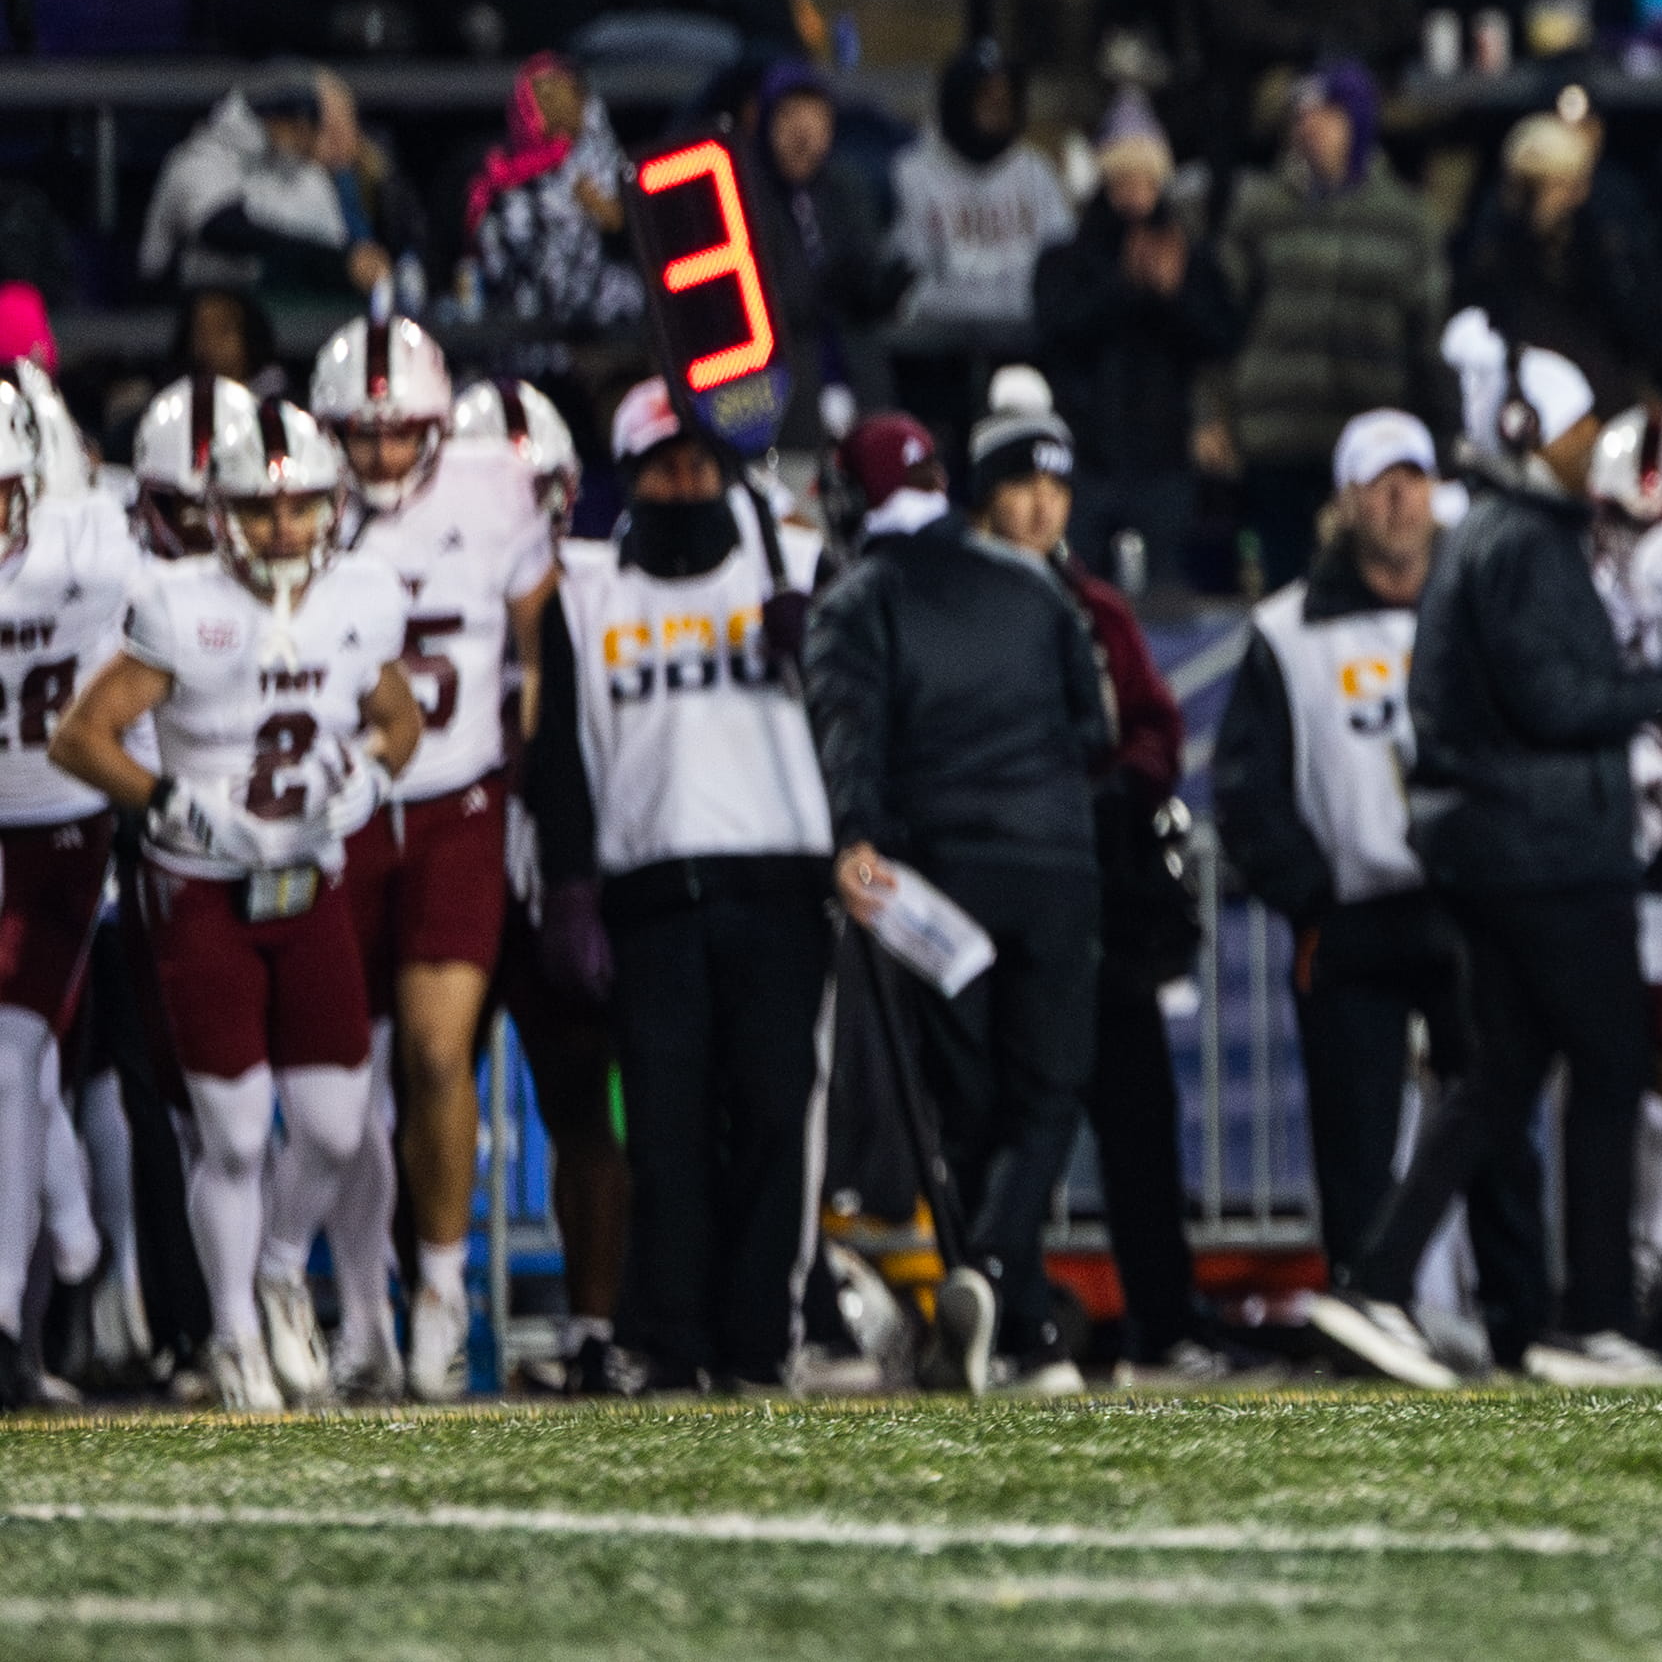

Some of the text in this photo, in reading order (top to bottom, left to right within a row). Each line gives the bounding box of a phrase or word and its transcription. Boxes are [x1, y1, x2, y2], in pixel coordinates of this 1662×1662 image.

[638, 139, 774, 393] 3
[0, 655, 78, 749] 8
[400, 610, 464, 731] 5
[246, 711, 318, 821] 2
